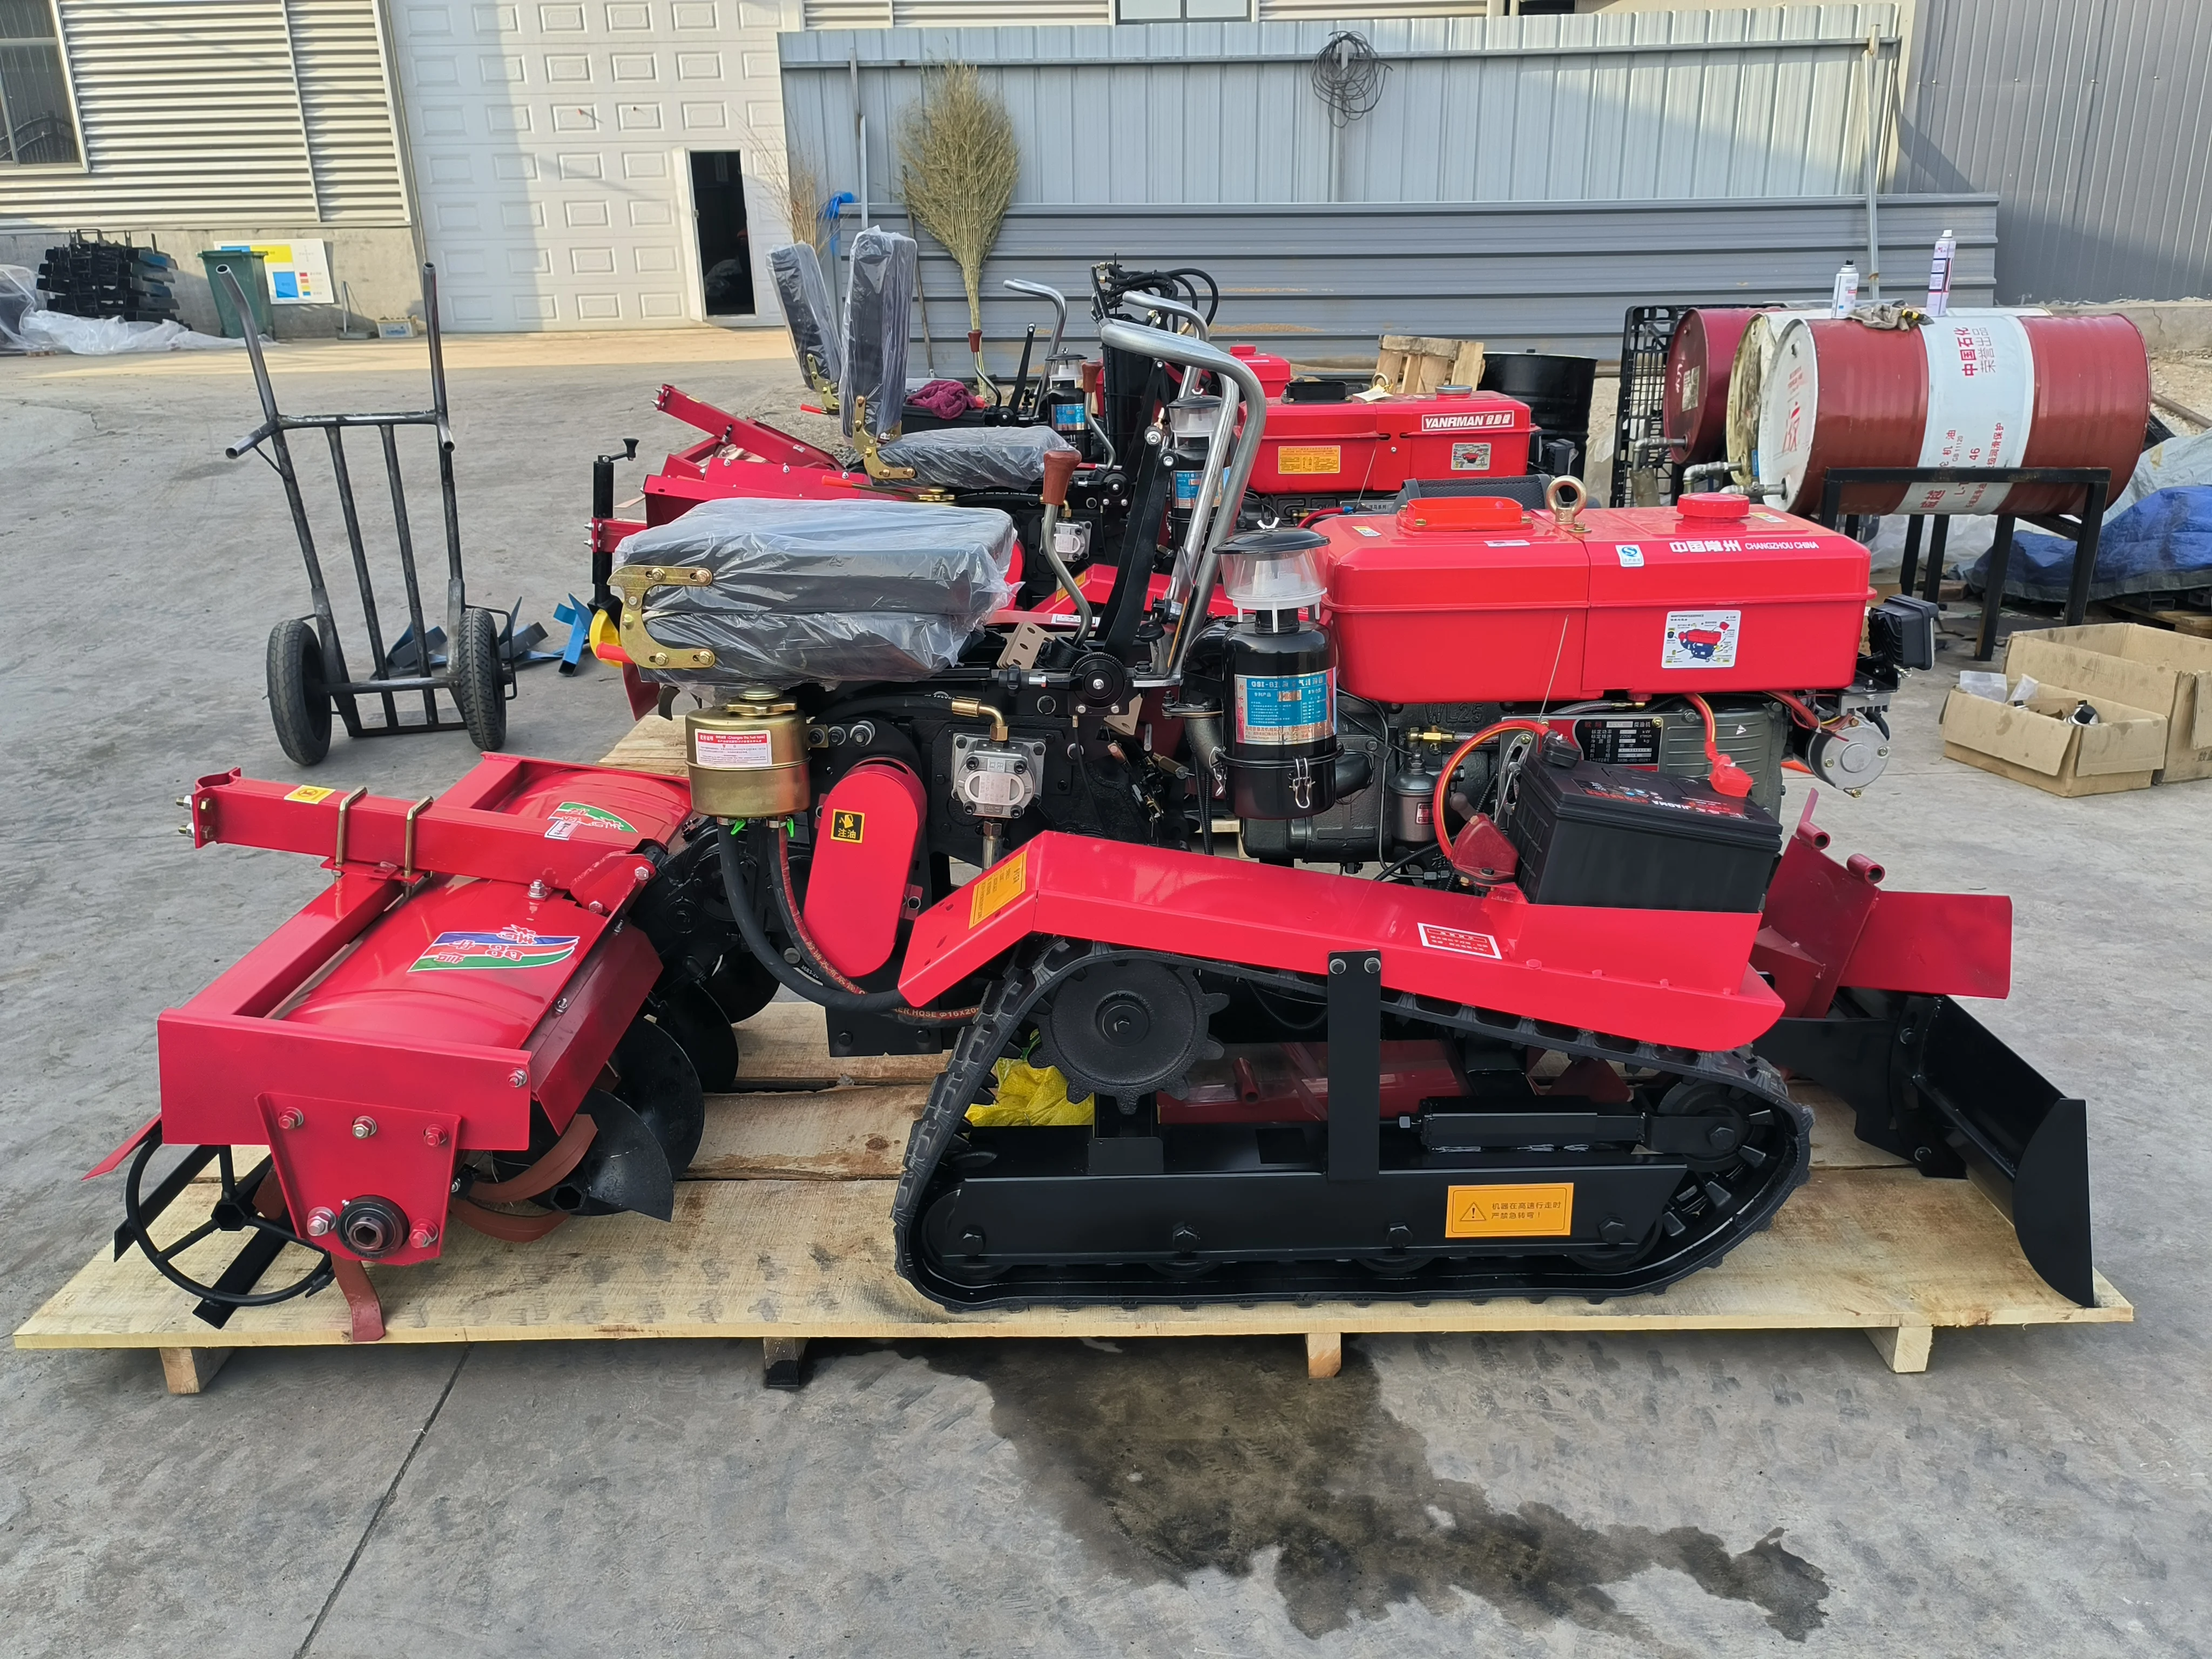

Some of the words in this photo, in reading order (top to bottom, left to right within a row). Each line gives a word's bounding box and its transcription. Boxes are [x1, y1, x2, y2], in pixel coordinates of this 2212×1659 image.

[1953, 327, 1978, 376] 中国石化
[1972, 327, 1996, 373] 荣誉出品
[1425, 415, 1484, 428] YANRMAN
[1969, 448, 1980, 460] 46
[1669, 540, 1742, 553] 中国常州
[1794, 541, 1819, 549] CHINA
[838, 828, 856, 839] 注油
[434, 939, 475, 964] 守信
[1492, 1201, 1562, 1210] 机器在高速行走时
